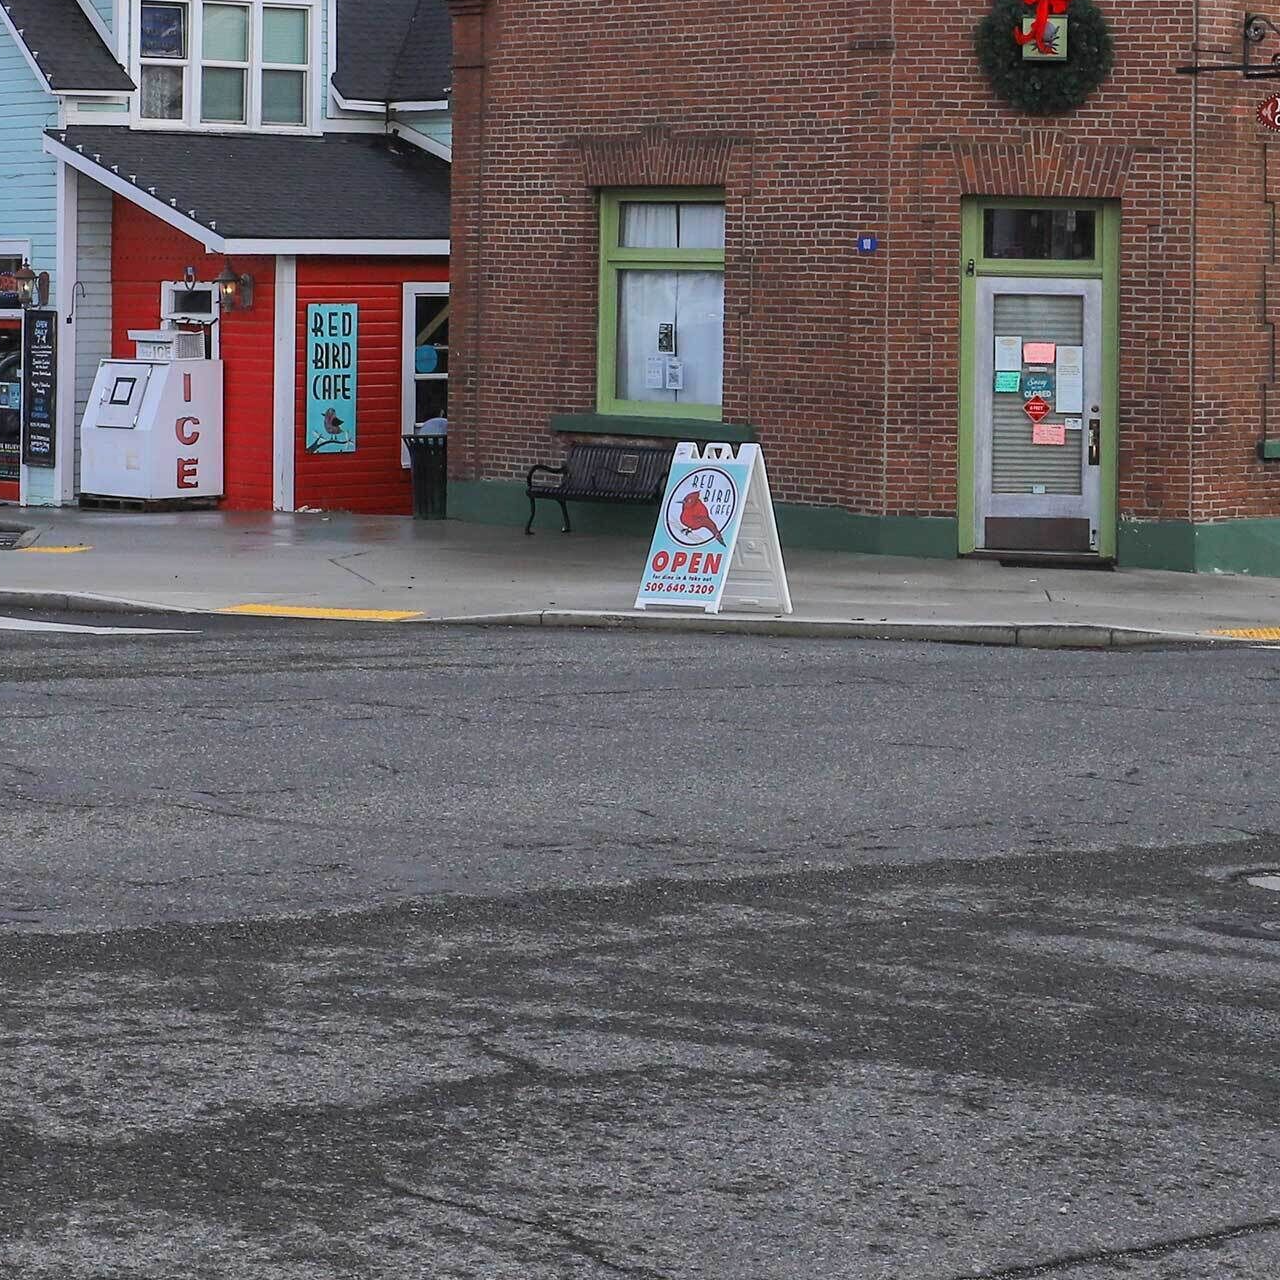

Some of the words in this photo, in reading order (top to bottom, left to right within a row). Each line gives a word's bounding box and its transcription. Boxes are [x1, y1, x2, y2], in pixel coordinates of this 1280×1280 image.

[312, 311, 352, 337] RED
[312, 342, 352, 370] BIRD
[312, 374, 352, 400] CAFE
[1024, 390, 1052, 398] CLOSED
[175, 370, 200, 489] ICE
[691, 474, 715, 489] RED
[703, 489, 732, 503] BIRD
[709, 504, 731, 517] CAFE
[651, 550, 723, 575] OPEN
[644, 582, 715, 596] 509.649.3209
